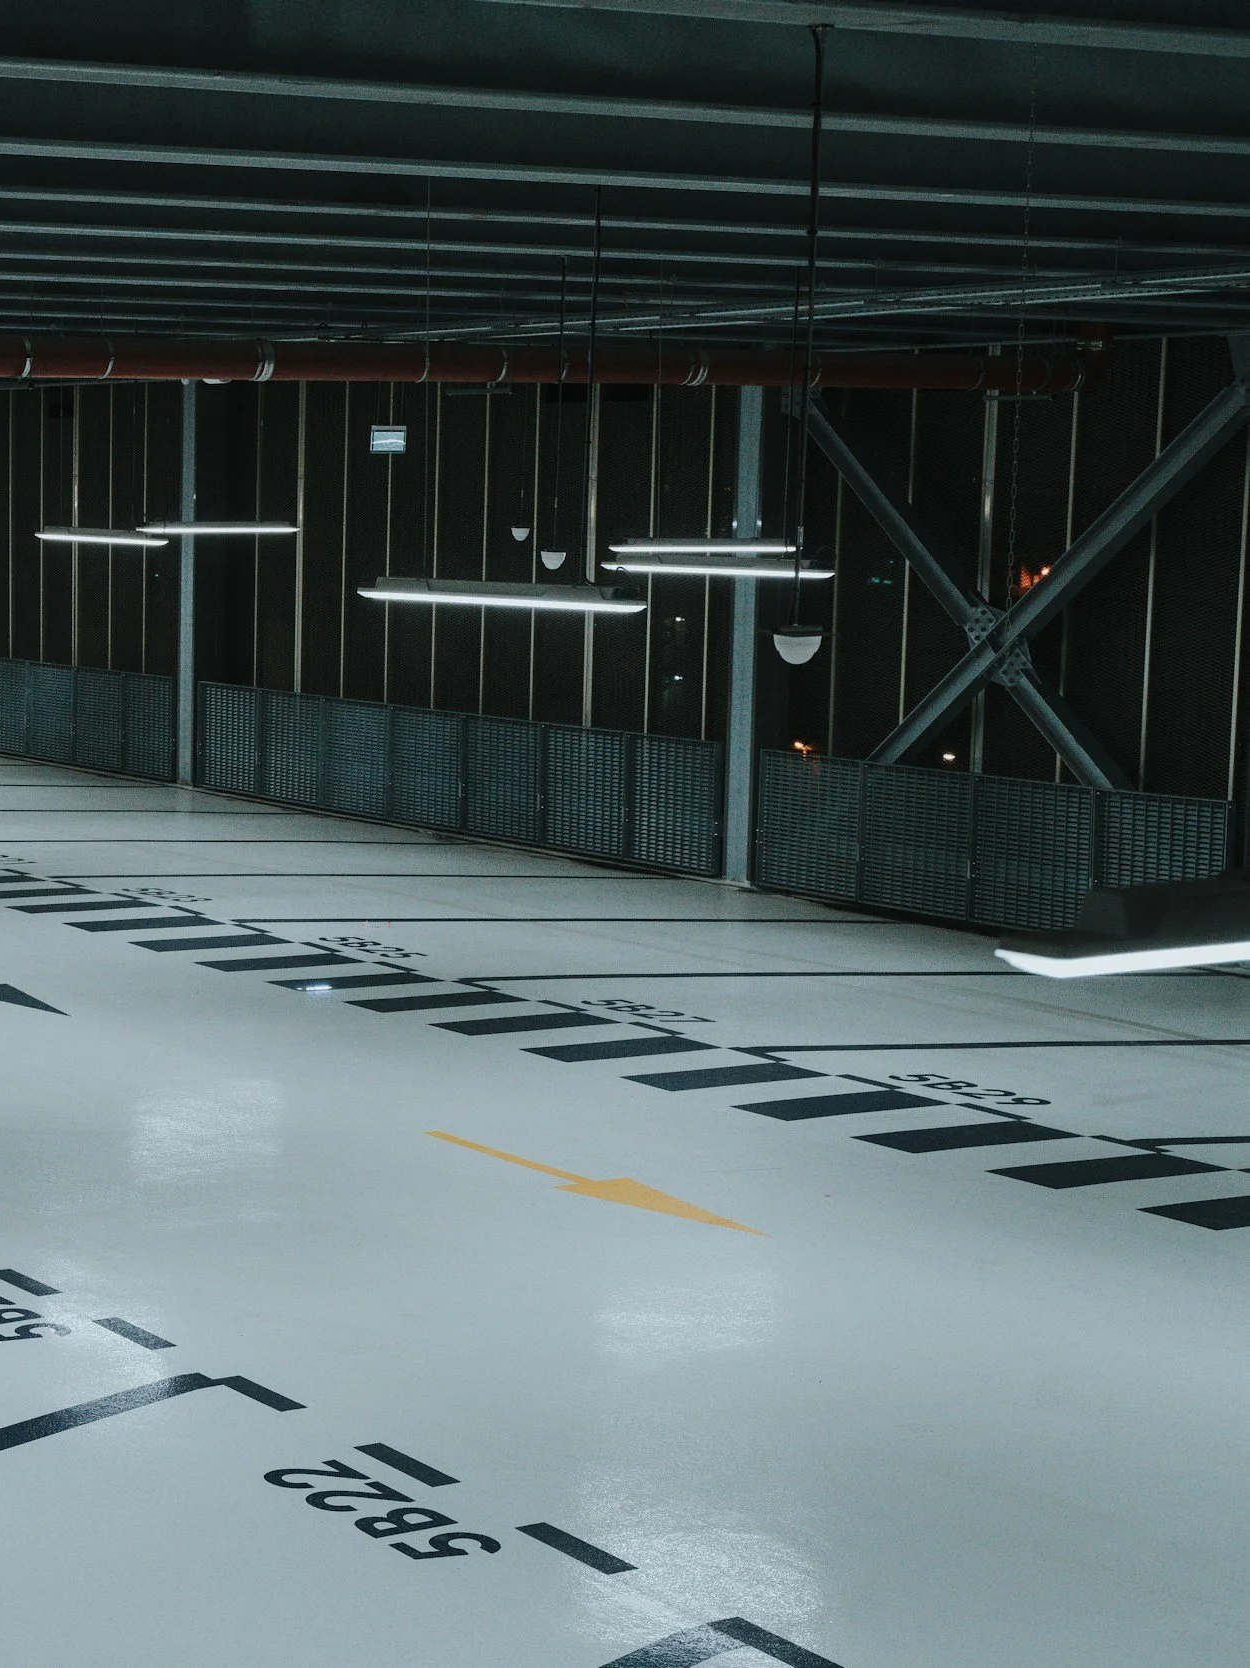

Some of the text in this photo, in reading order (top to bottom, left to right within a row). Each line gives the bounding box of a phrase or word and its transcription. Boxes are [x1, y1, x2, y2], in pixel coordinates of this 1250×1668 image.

[122, 887, 213, 902] 5B23
[318, 936, 430, 959] 5B25
[582, 998, 717, 1023] 5B27
[888, 1073, 1052, 1106] 5B29
[264, 1459, 501, 1560] 5B22
